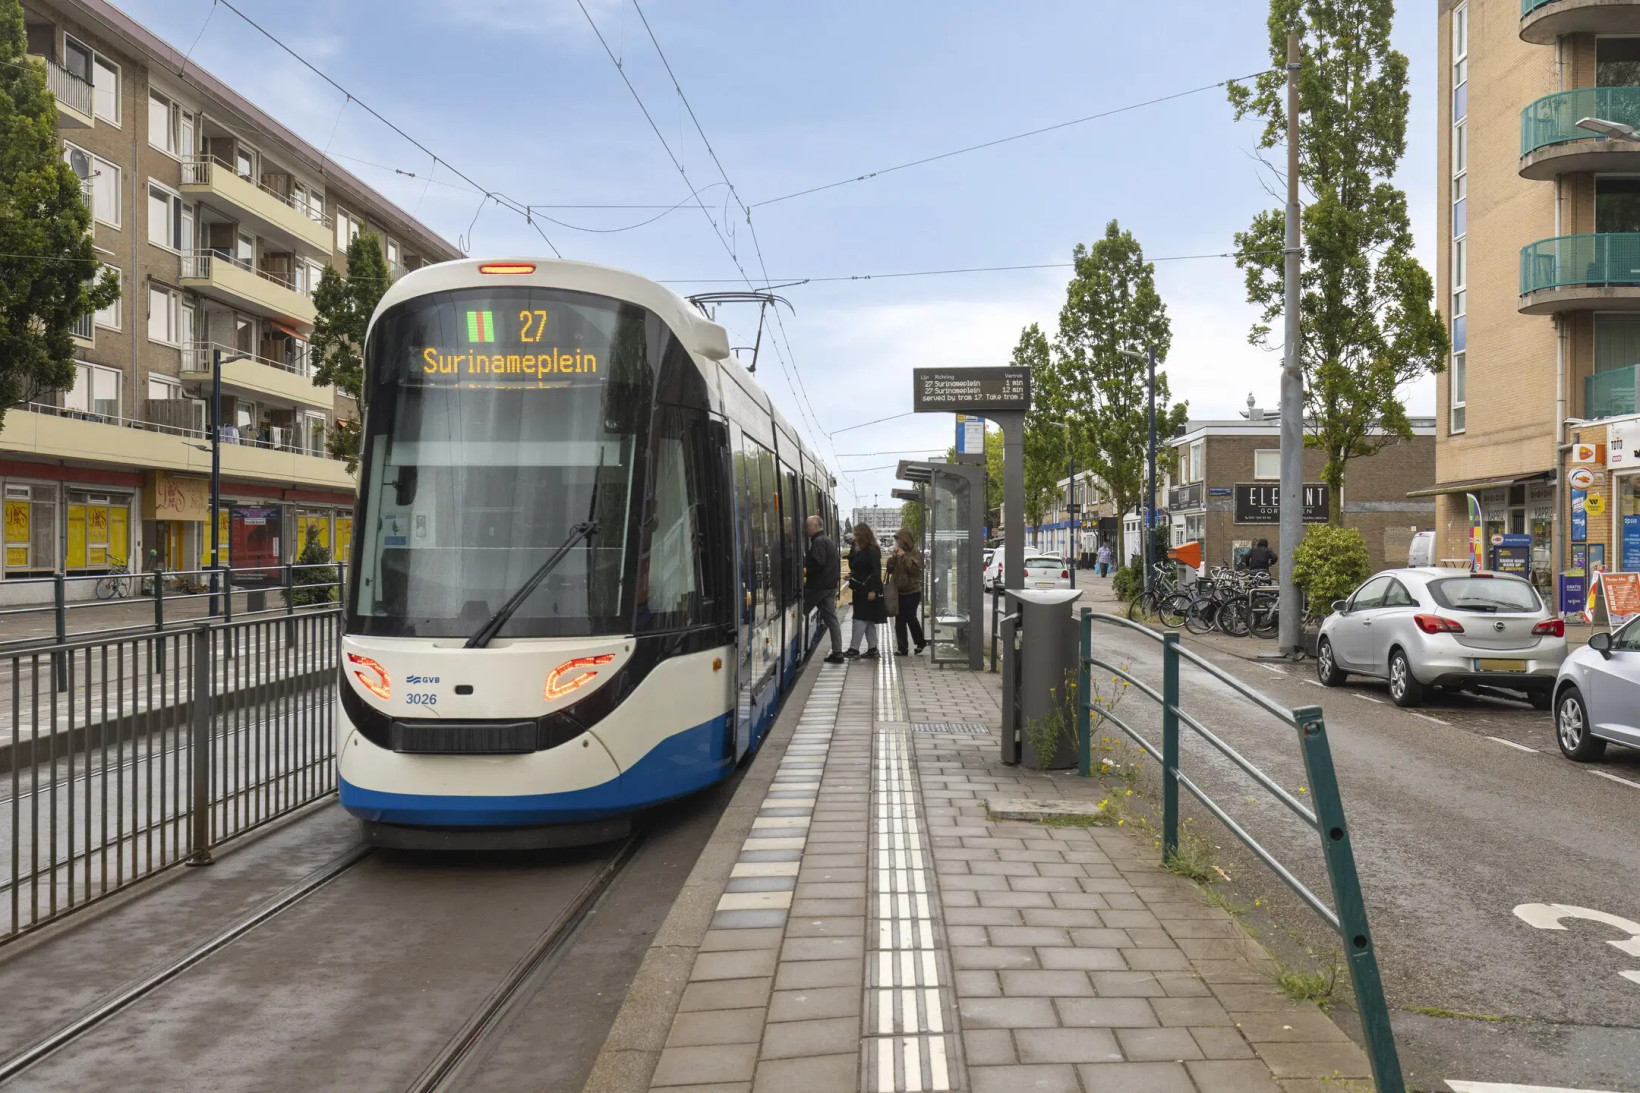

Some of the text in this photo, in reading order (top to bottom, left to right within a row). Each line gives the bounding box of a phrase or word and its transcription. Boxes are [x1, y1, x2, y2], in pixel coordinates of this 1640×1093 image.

[519, 310, 547, 342] 27
[423, 347, 597, 379] Surinameplein
[1249, 487, 1324, 506] ELENT
[422, 676, 440, 684] GVB
[406, 693, 437, 705] 3026
